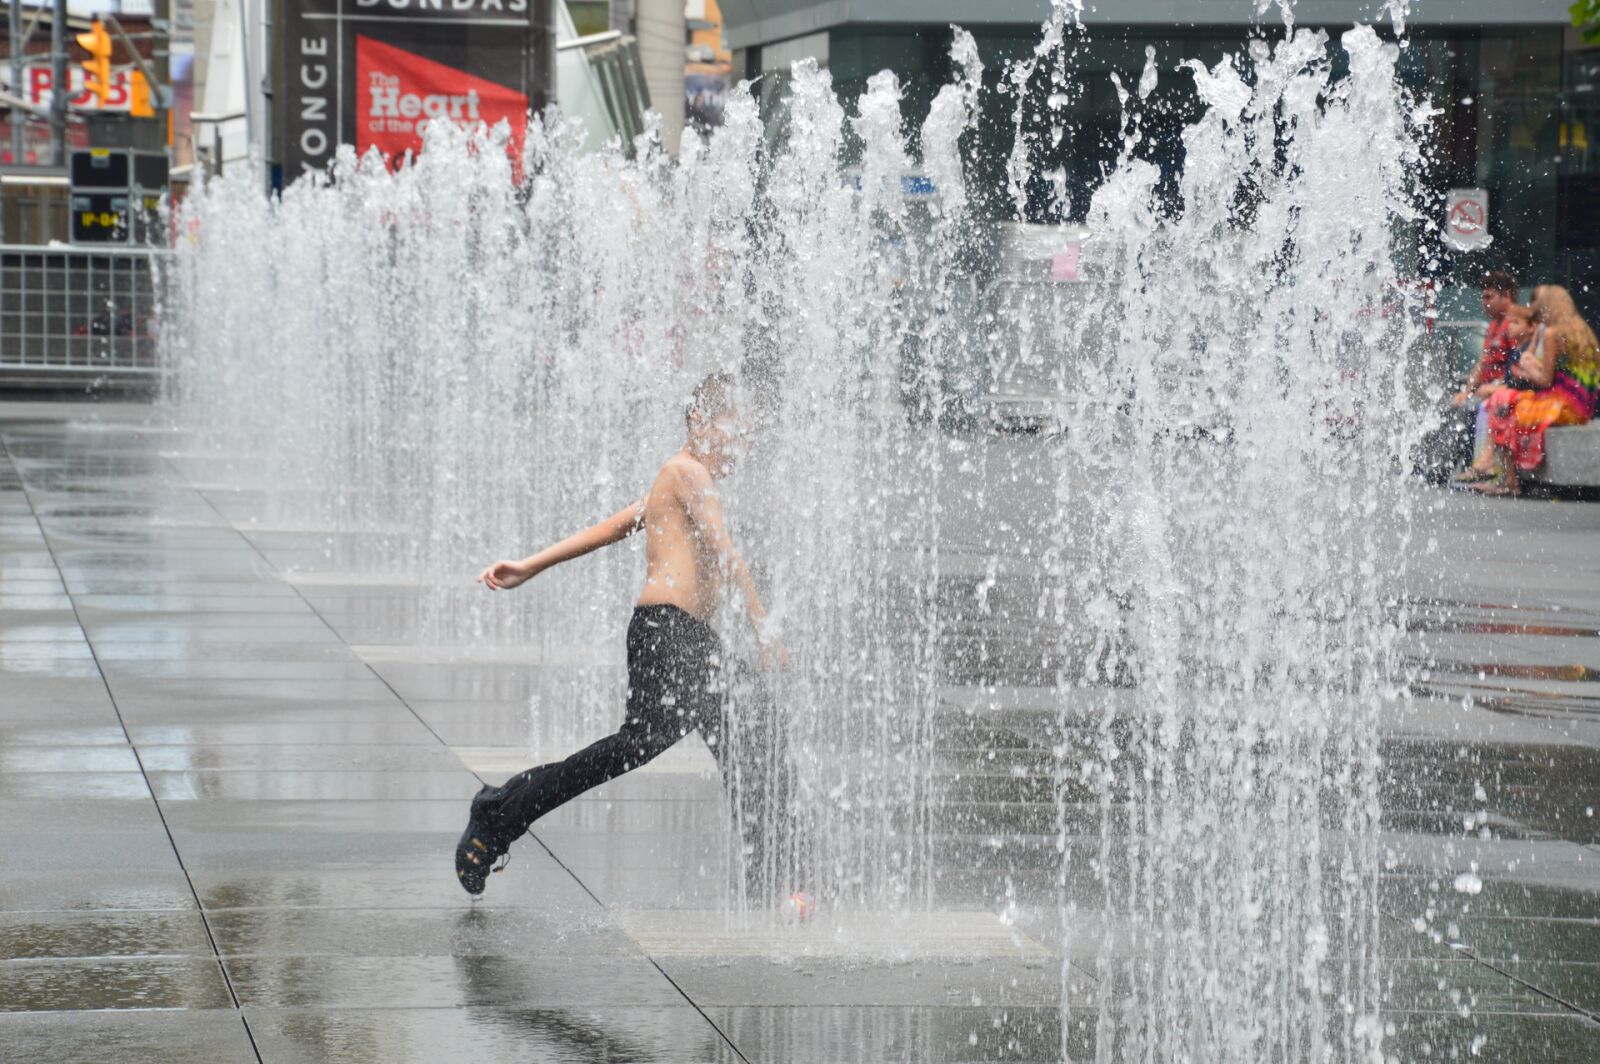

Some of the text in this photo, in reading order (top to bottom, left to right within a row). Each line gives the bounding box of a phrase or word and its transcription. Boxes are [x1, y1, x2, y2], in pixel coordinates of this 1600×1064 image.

[368, 71, 400, 87] The
[369, 87, 480, 119] Heart
[387, 118, 414, 132] the
